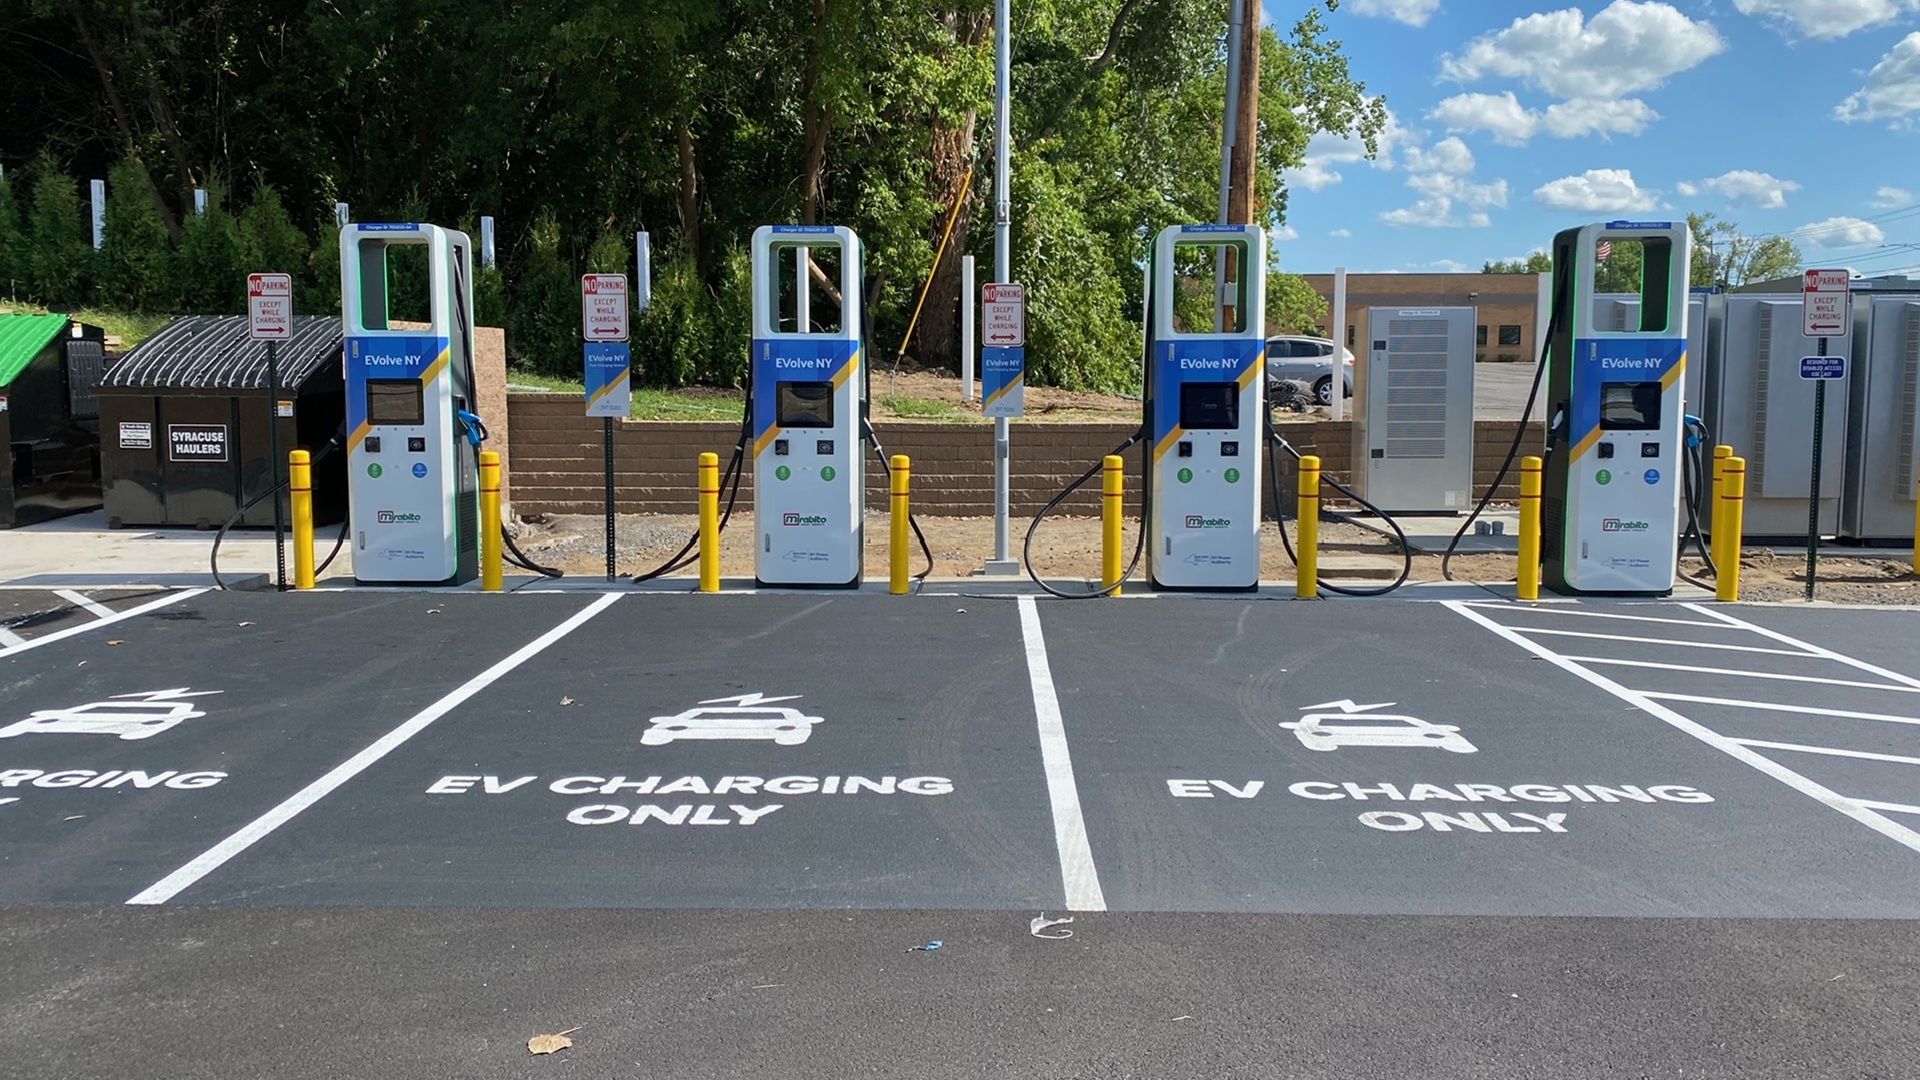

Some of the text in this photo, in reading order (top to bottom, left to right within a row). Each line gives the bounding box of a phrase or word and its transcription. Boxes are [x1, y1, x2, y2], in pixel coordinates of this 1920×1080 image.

[250, 280, 288, 292] NO PARKING
[584, 279, 624, 292] NO PARKING
[1806, 275, 1846, 288] NO PARKING
[984, 288, 1020, 300] NO PARKING
[364, 354, 421, 366] EVolve NY
[776, 358, 832, 368] EVolve NY
[1180, 358, 1239, 368] EVolve NY
[1602, 358, 1662, 368] EVolve NY
[172, 432, 224, 442] SYRACUSE
[176, 444, 221, 454] HAULERS
[426, 776, 954, 795] EV CHARGING
[1167, 780, 1715, 803] EV CHARGING
[567, 805, 783, 824] ONLY
[1358, 811, 1568, 832] ONLY
